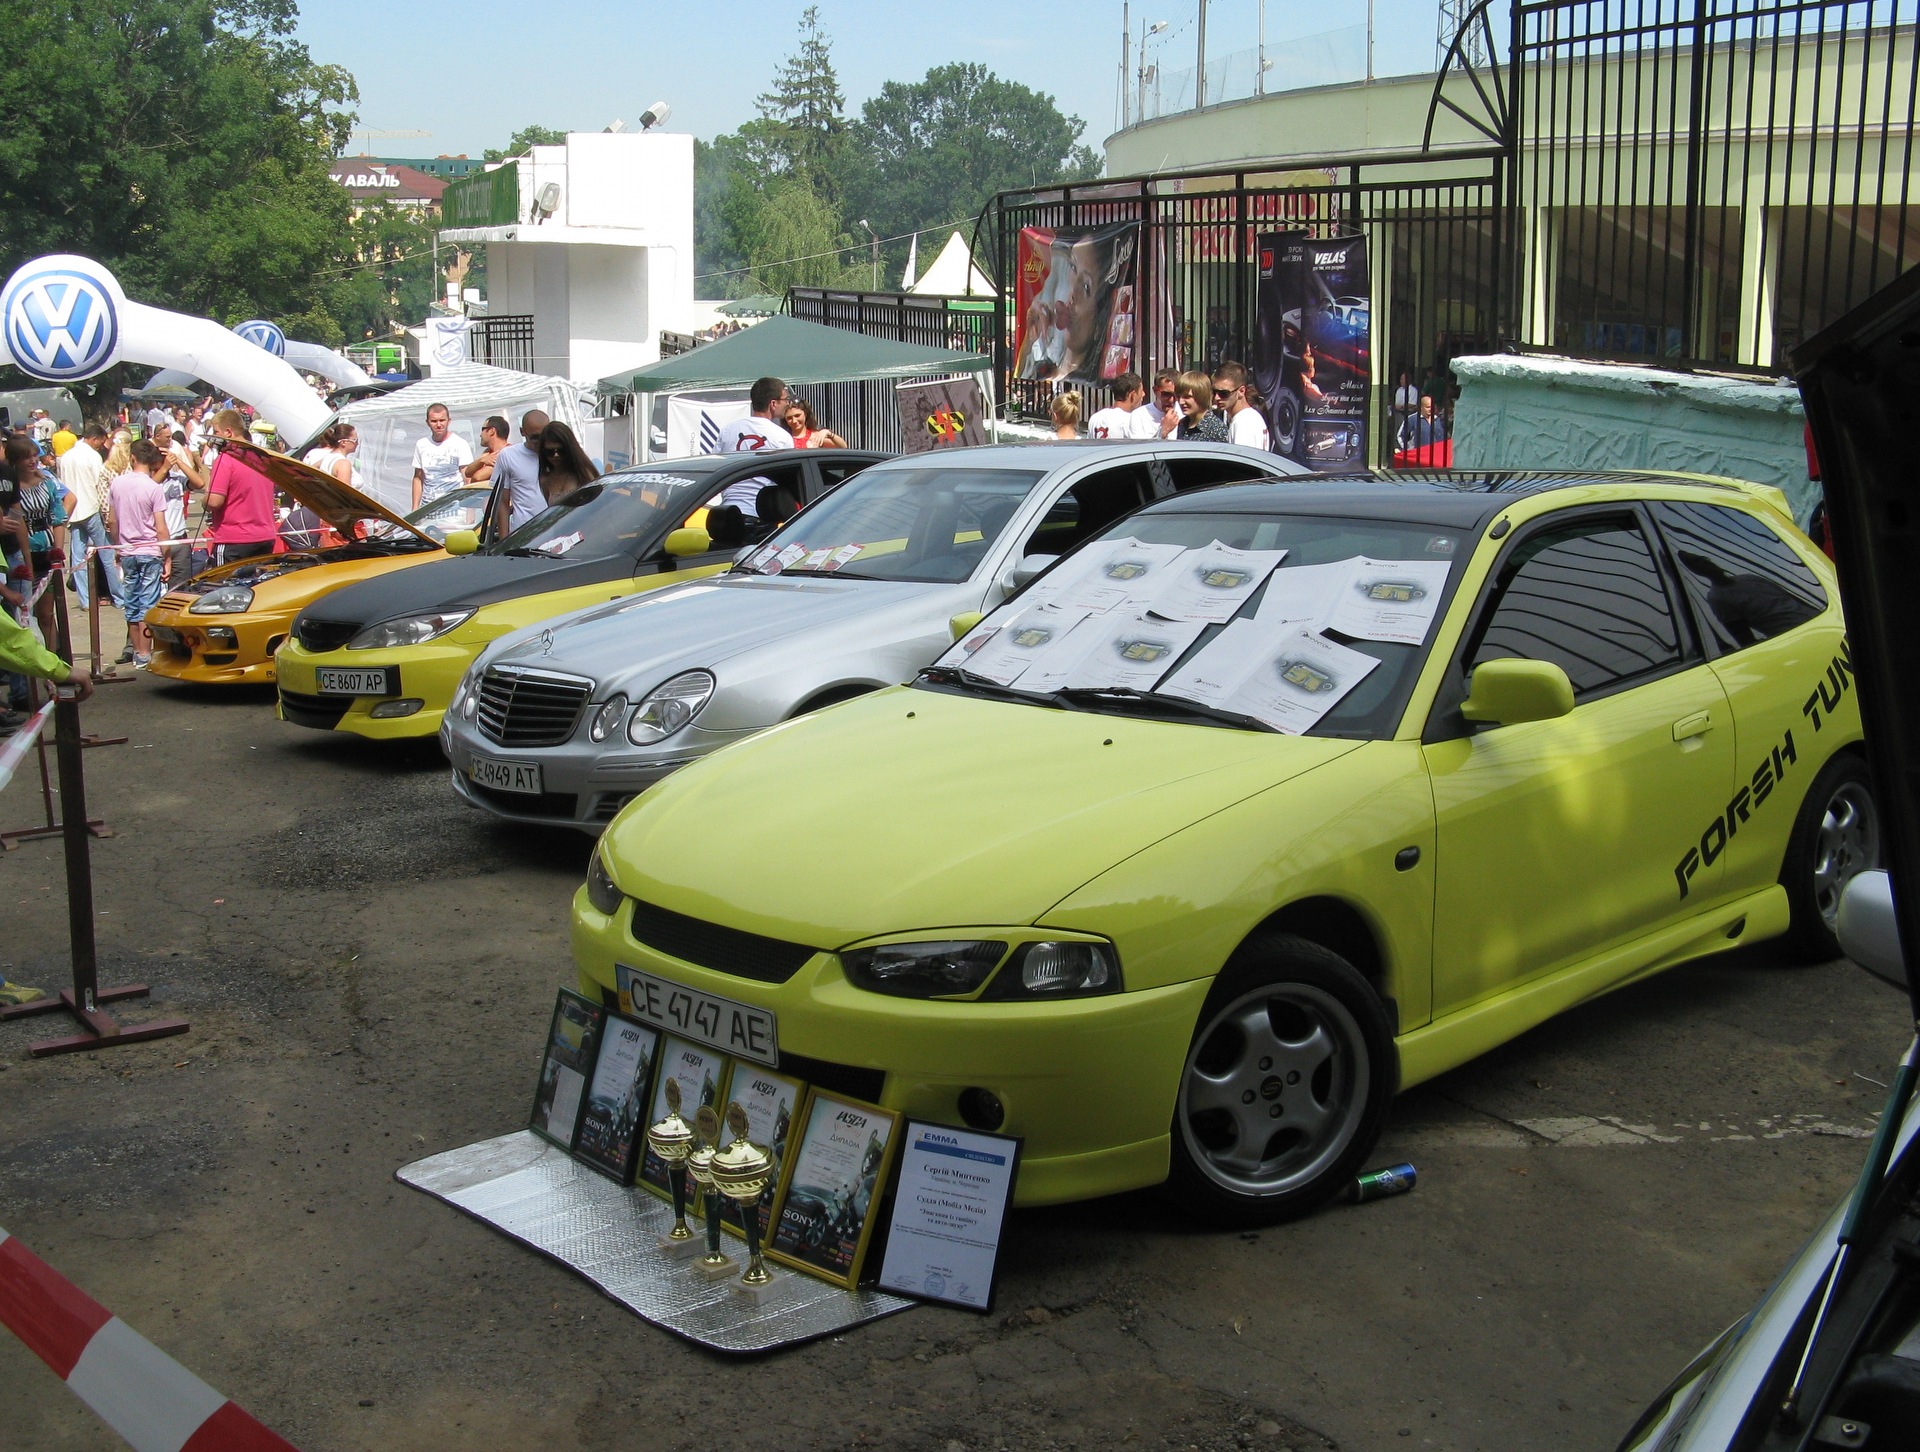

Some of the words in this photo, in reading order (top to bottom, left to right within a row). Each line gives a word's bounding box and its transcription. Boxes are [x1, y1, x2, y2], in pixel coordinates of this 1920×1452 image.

[344, 174, 400, 187] АВАЛЬ
[1314, 251, 1346, 265] VELAS
[322, 673, 336, 690] CE
[338, 674, 362, 691] 8607
[366, 674, 383, 691] AP
[472, 758, 483, 777] CE
[484, 761, 510, 787] 4949
[515, 767, 535, 789] AT
[1674, 728, 1797, 901] FORSH
[630, 977, 663, 1019] CE
[668, 991, 721, 1038] 4747
[730, 1010, 767, 1054] AE
[682, 1051, 703, 1067] IASCA
[752, 1080, 776, 1096] IASCA
[585, 1117, 606, 1132] SONY
[835, 1110, 867, 1128] IASCA
[924, 1132, 958, 1145] EMMA
[923, 1164, 949, 1177] Сергій
[782, 1209, 816, 1227] SONY
